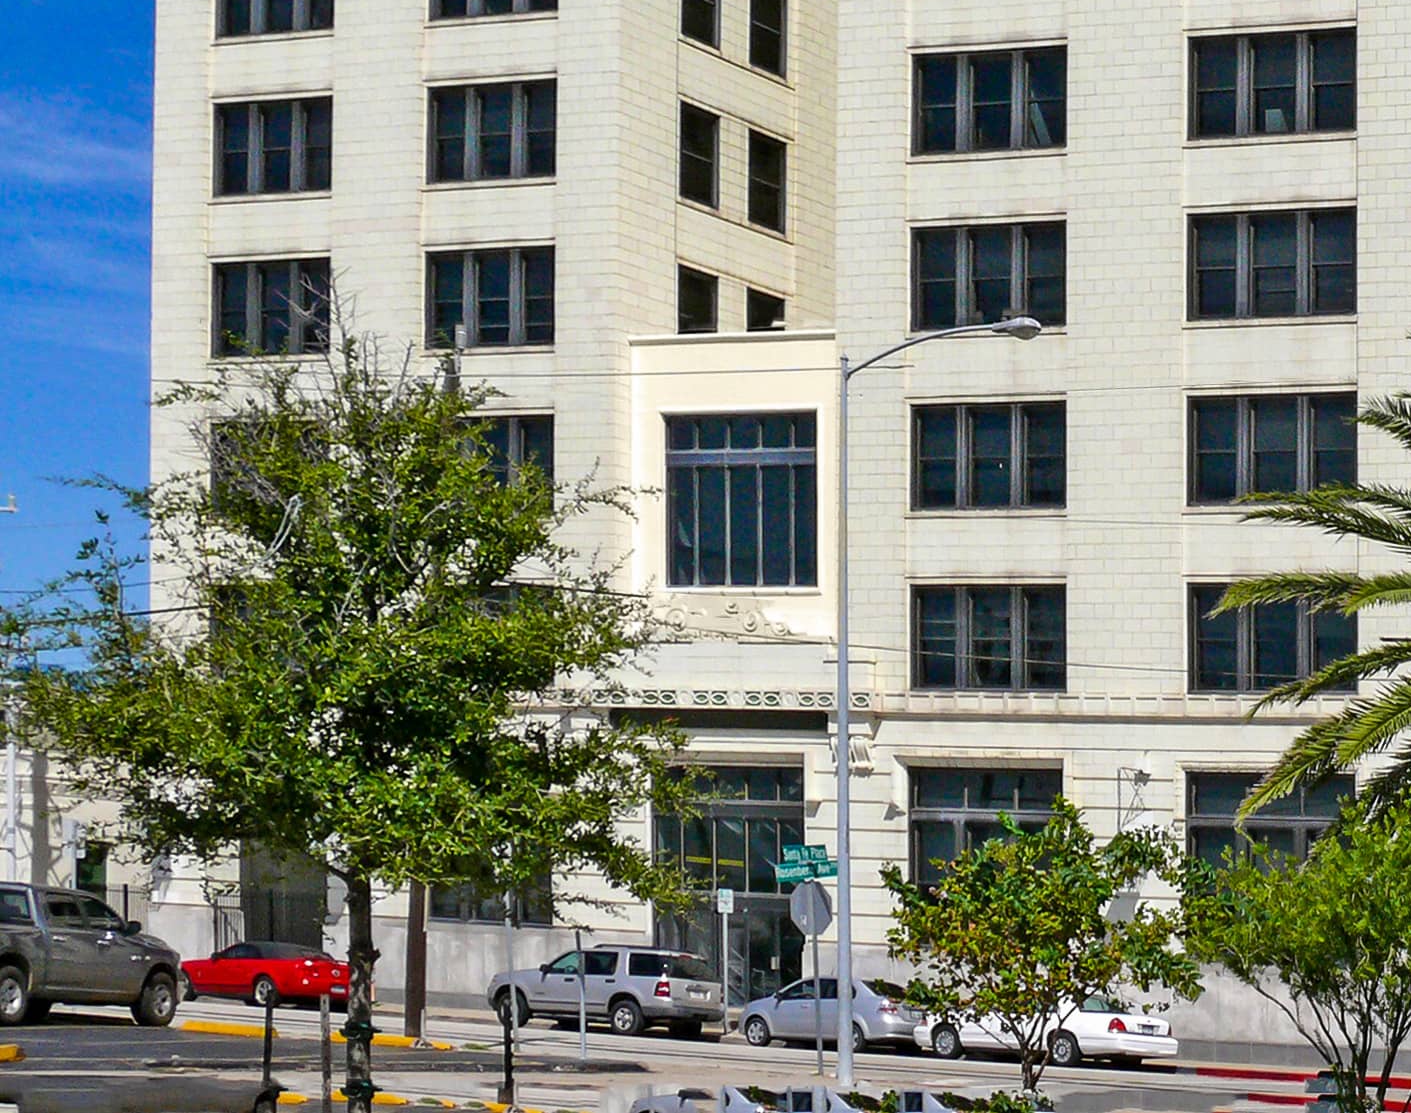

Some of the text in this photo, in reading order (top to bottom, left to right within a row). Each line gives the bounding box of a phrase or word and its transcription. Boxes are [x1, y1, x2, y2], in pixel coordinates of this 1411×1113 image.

[783, 847, 826, 862] Santa Fe Place
